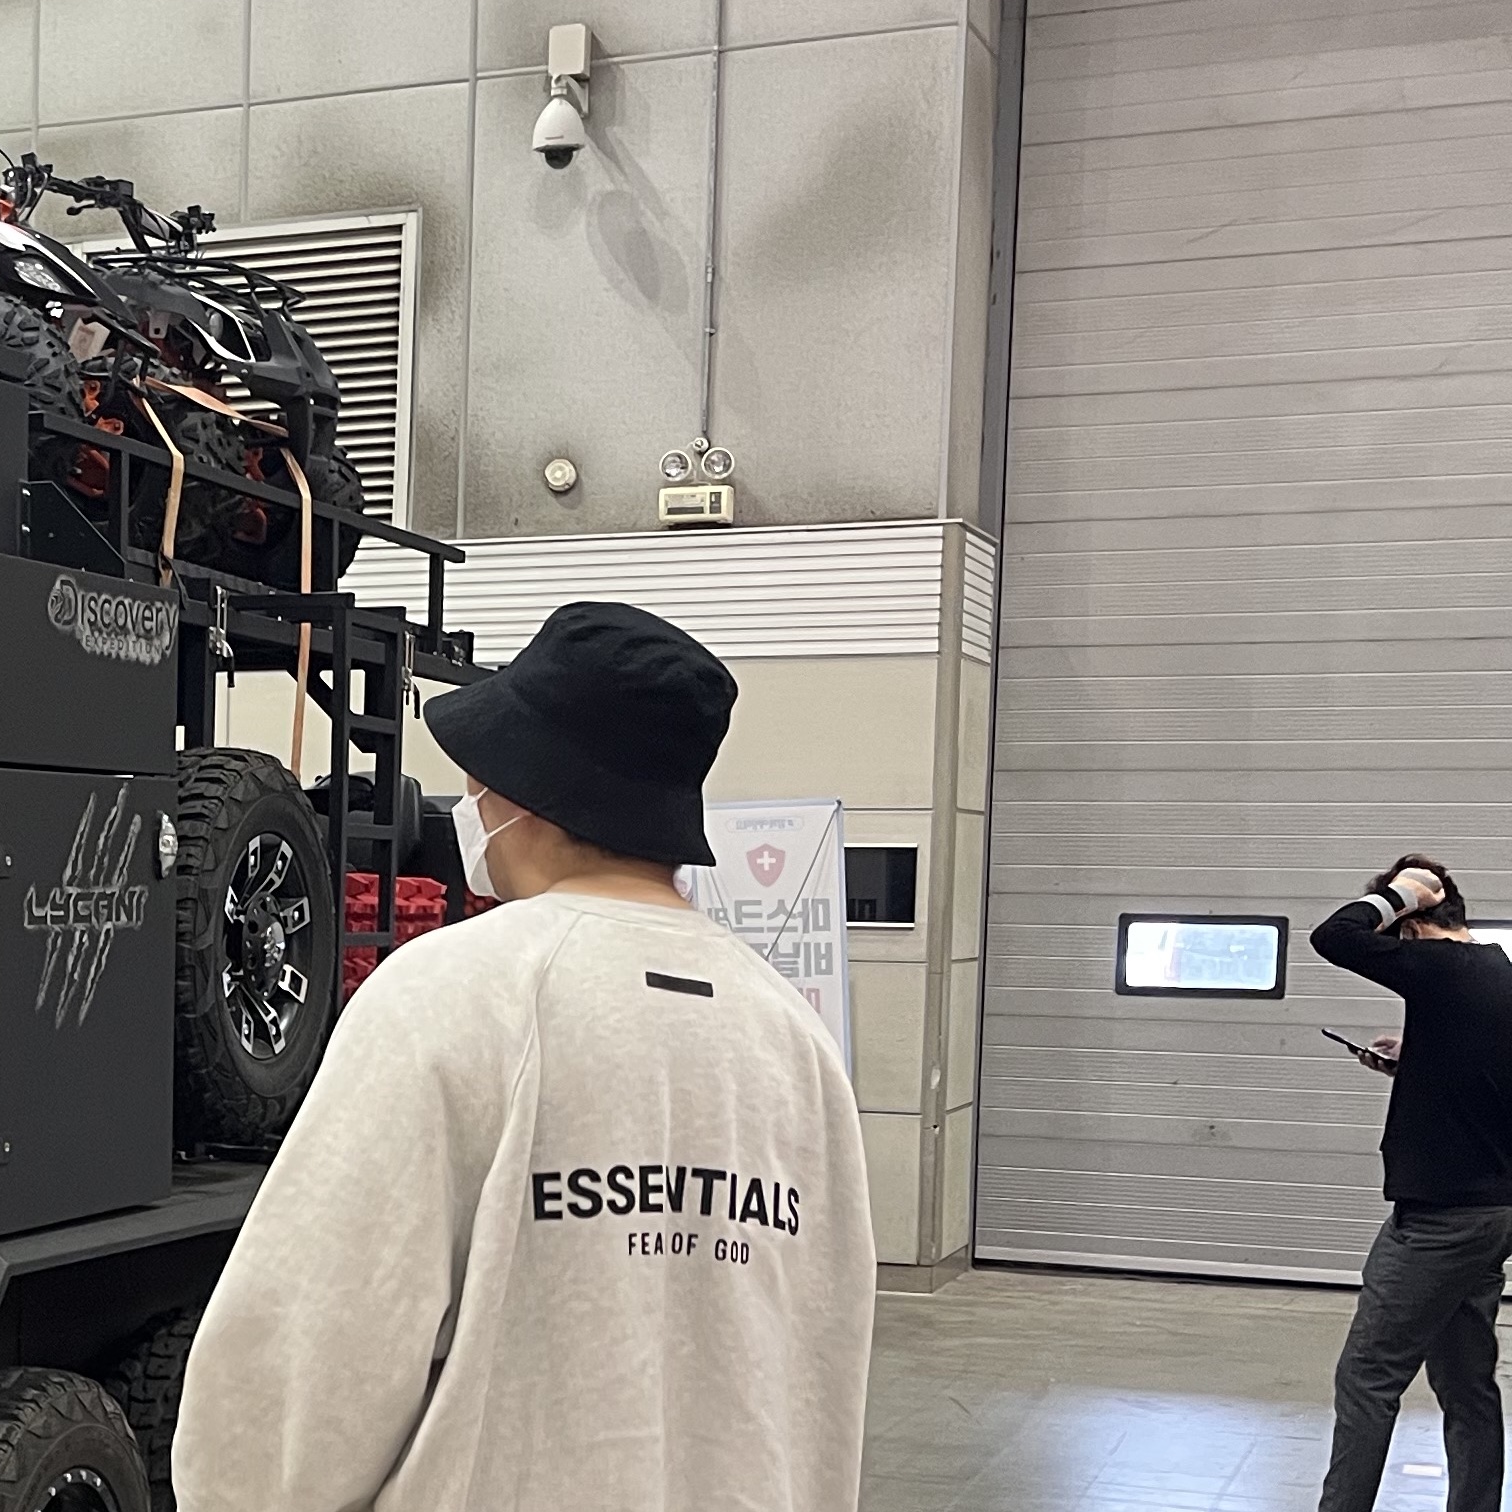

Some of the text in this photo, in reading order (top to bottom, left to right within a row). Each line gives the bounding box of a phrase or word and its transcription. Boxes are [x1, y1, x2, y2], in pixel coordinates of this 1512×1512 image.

[51, 580, 177, 650] Discovery
[85, 634, 162, 655] EXPEDITION
[532, 1165, 800, 1236] ESSENTIALS
[628, 1232, 664, 1256] FEA
[714, 1238, 750, 1265] GOD
